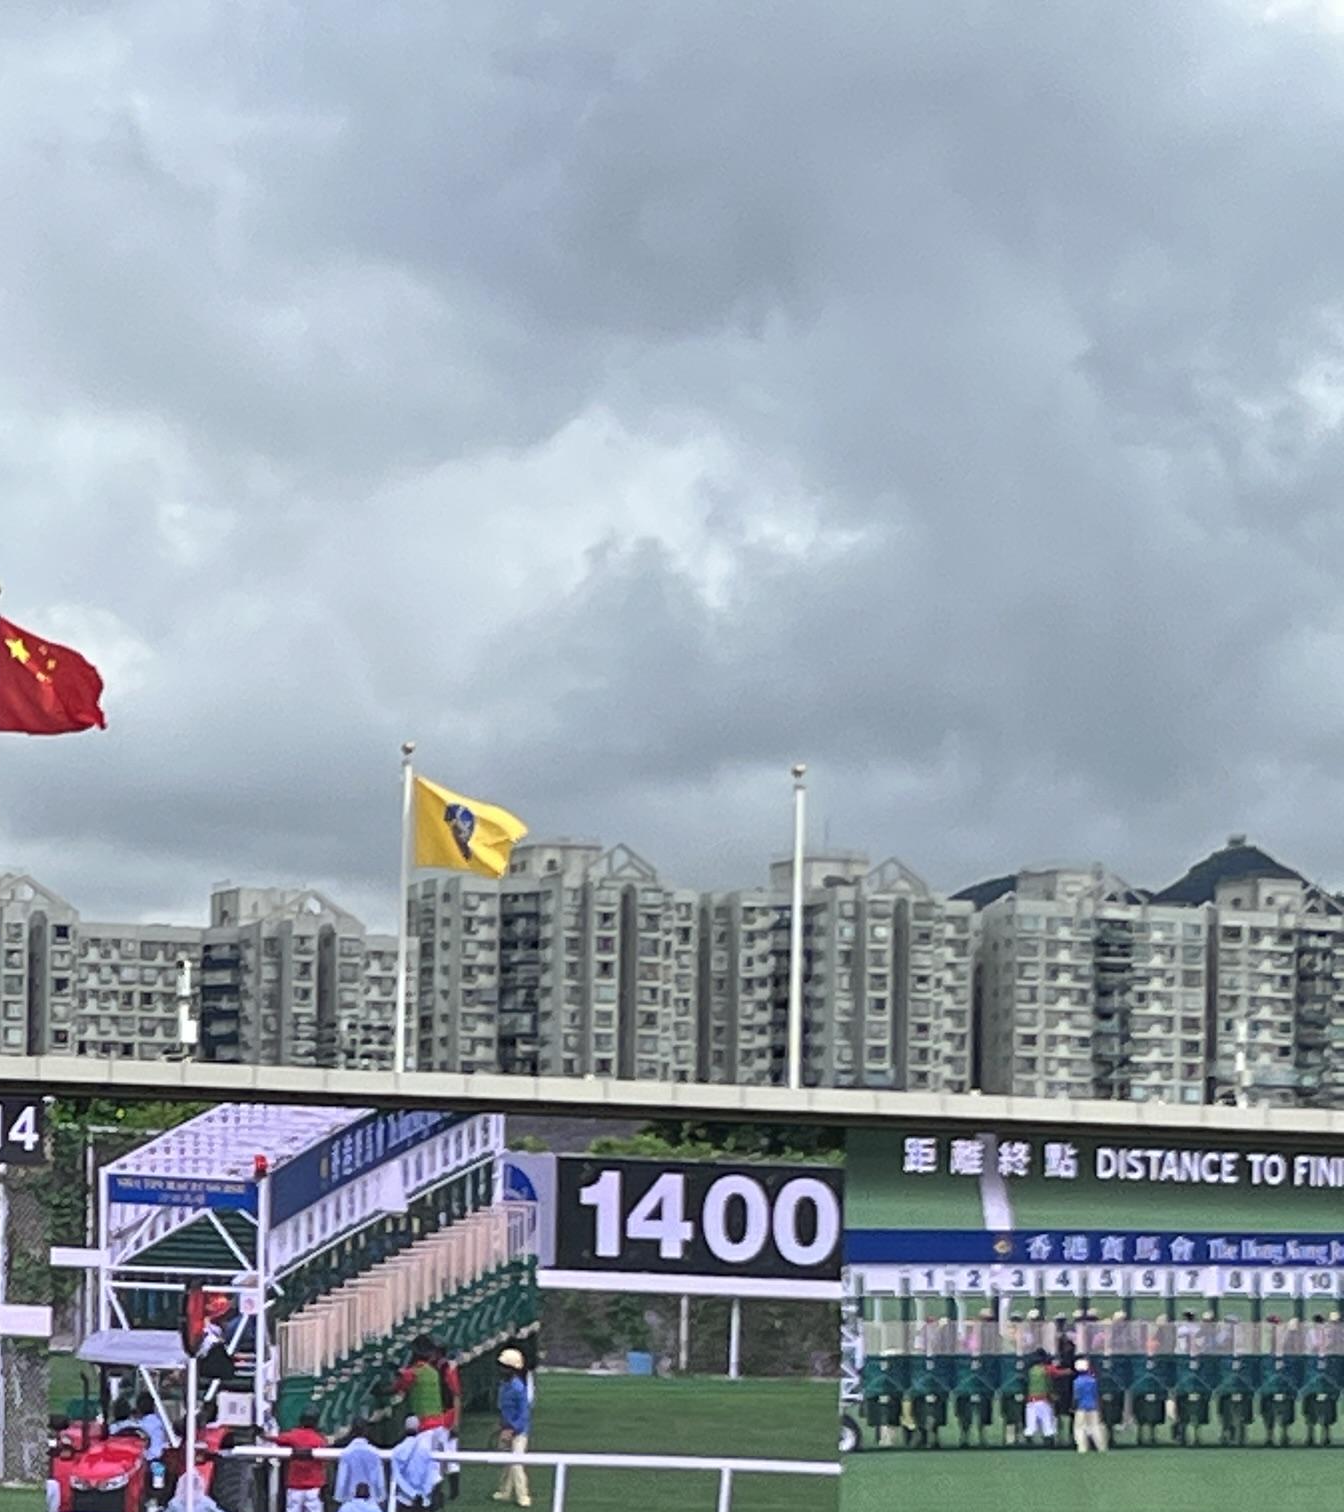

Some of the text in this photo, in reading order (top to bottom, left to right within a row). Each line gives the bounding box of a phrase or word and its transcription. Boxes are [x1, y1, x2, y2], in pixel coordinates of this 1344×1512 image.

[903, 1136, 1344, 1187] 距離終點 DISTANCE TO FINI
[579, 1169, 839, 1265] 1400
[922, 1271, 934, 1287] 1
[966, 1270, 981, 1287] 2
[1012, 1270, 1025, 1287] 3
[1056, 1270, 1070, 1287] 4
[1099, 1269, 1113, 1288] 5
[1186, 1270, 1199, 1288] 7
[1272, 1271, 1285, 1289] 9
[1310, 1272, 1331, 1289] 10
